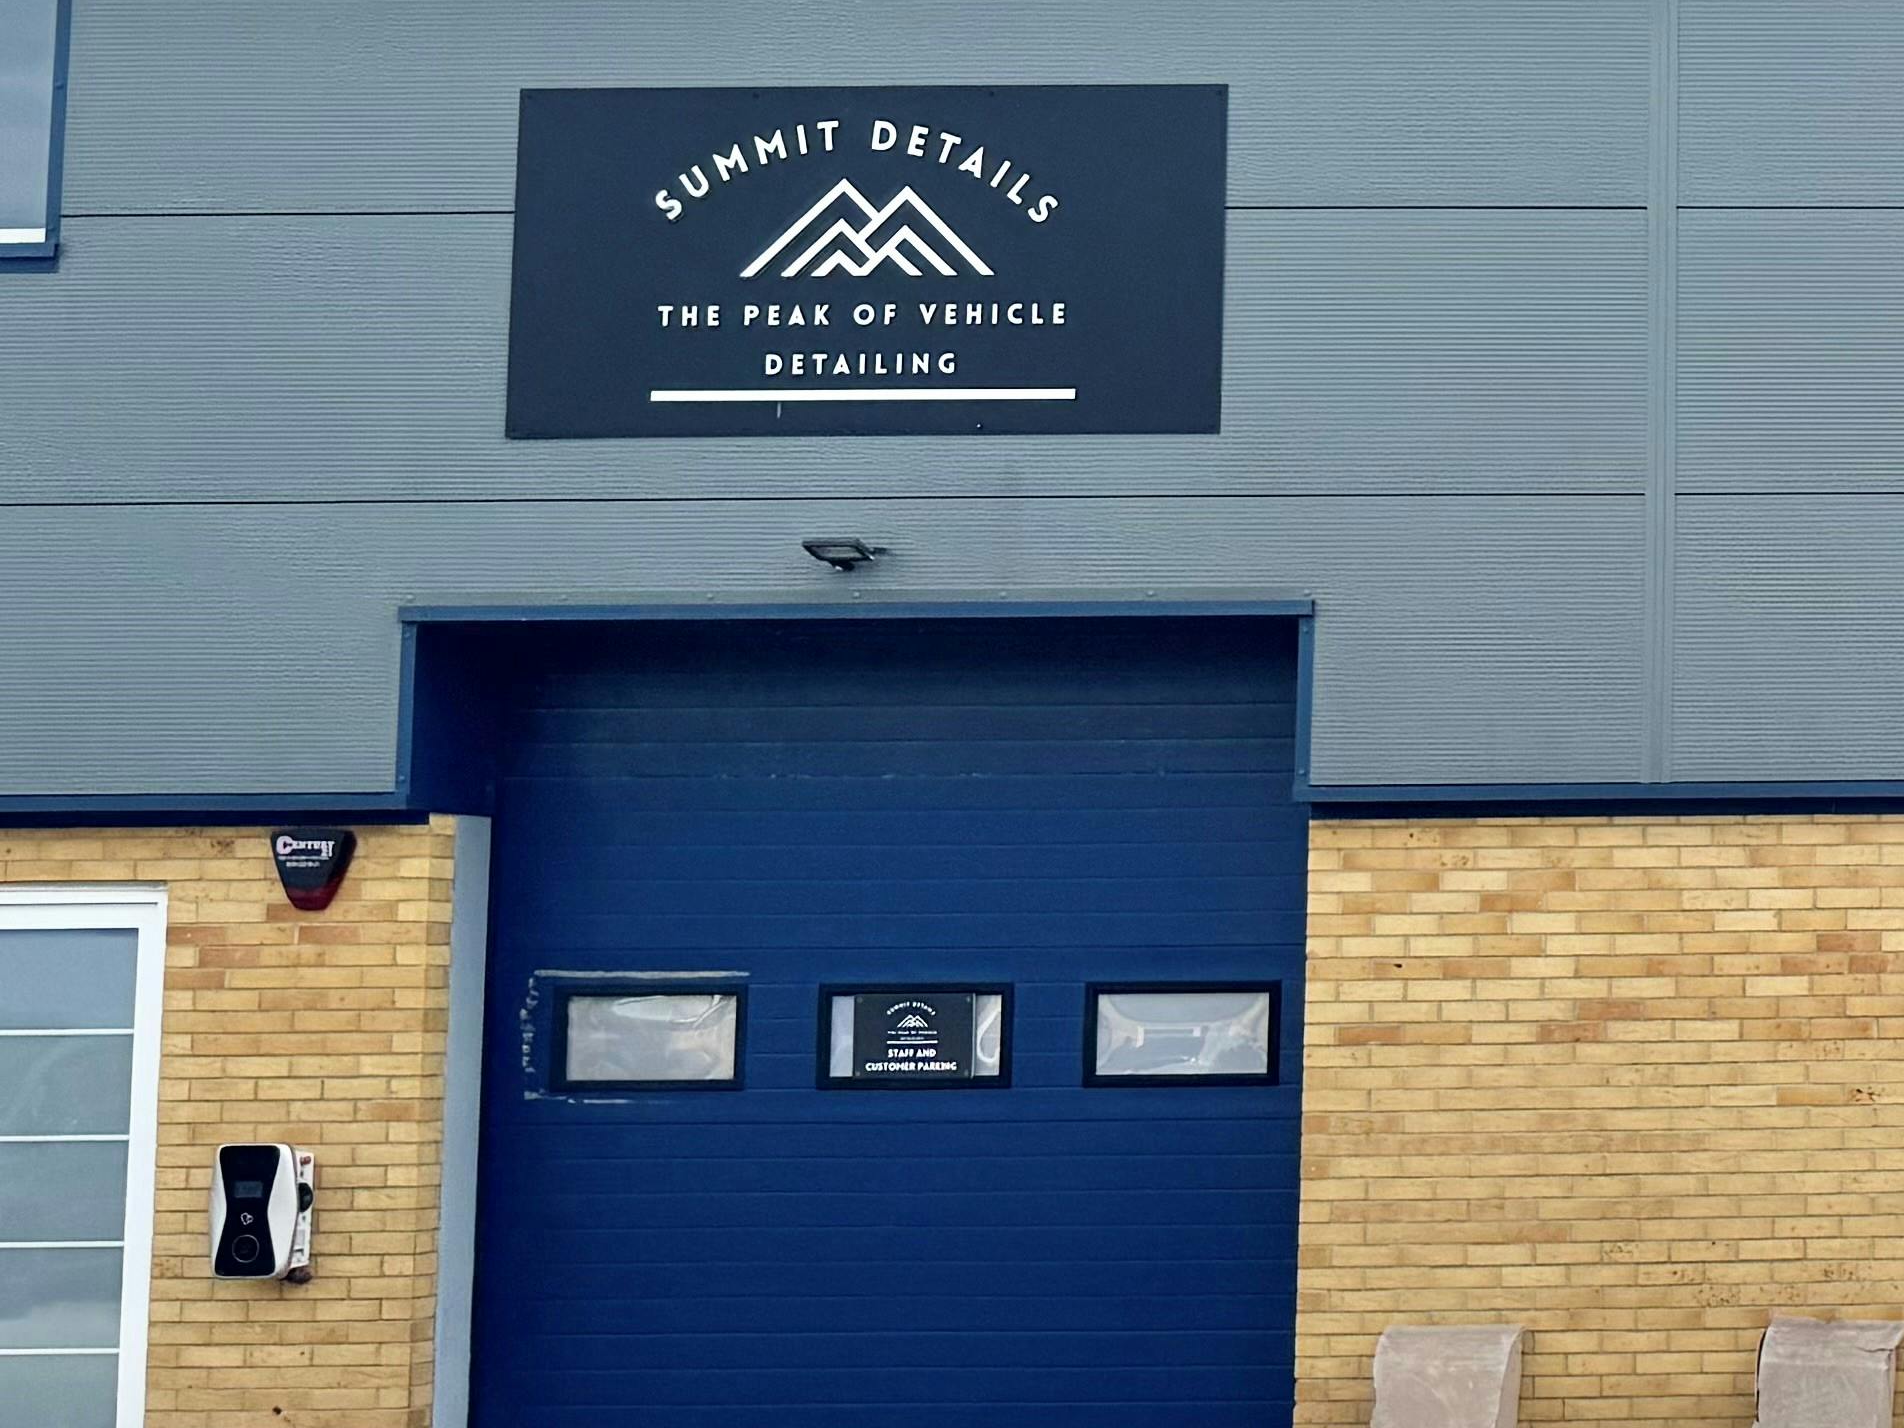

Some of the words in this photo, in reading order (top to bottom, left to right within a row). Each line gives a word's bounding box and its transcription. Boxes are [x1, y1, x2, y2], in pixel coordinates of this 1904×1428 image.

[654, 119, 840, 222] SUMMIT
[871, 119, 1060, 225] DETAILS
[657, 304, 721, 327] THE
[743, 303, 831, 327] PEAK
[853, 302, 898, 327] OF
[919, 302, 1066, 326] VEHICLE
[764, 352, 956, 376] DETAILING
[887, 1048, 915, 1058] STAFF
[916, 1048, 937, 1058] AND
[865, 1061, 916, 1072] CUSTOMER
[917, 1061, 958, 1071] PARKING
